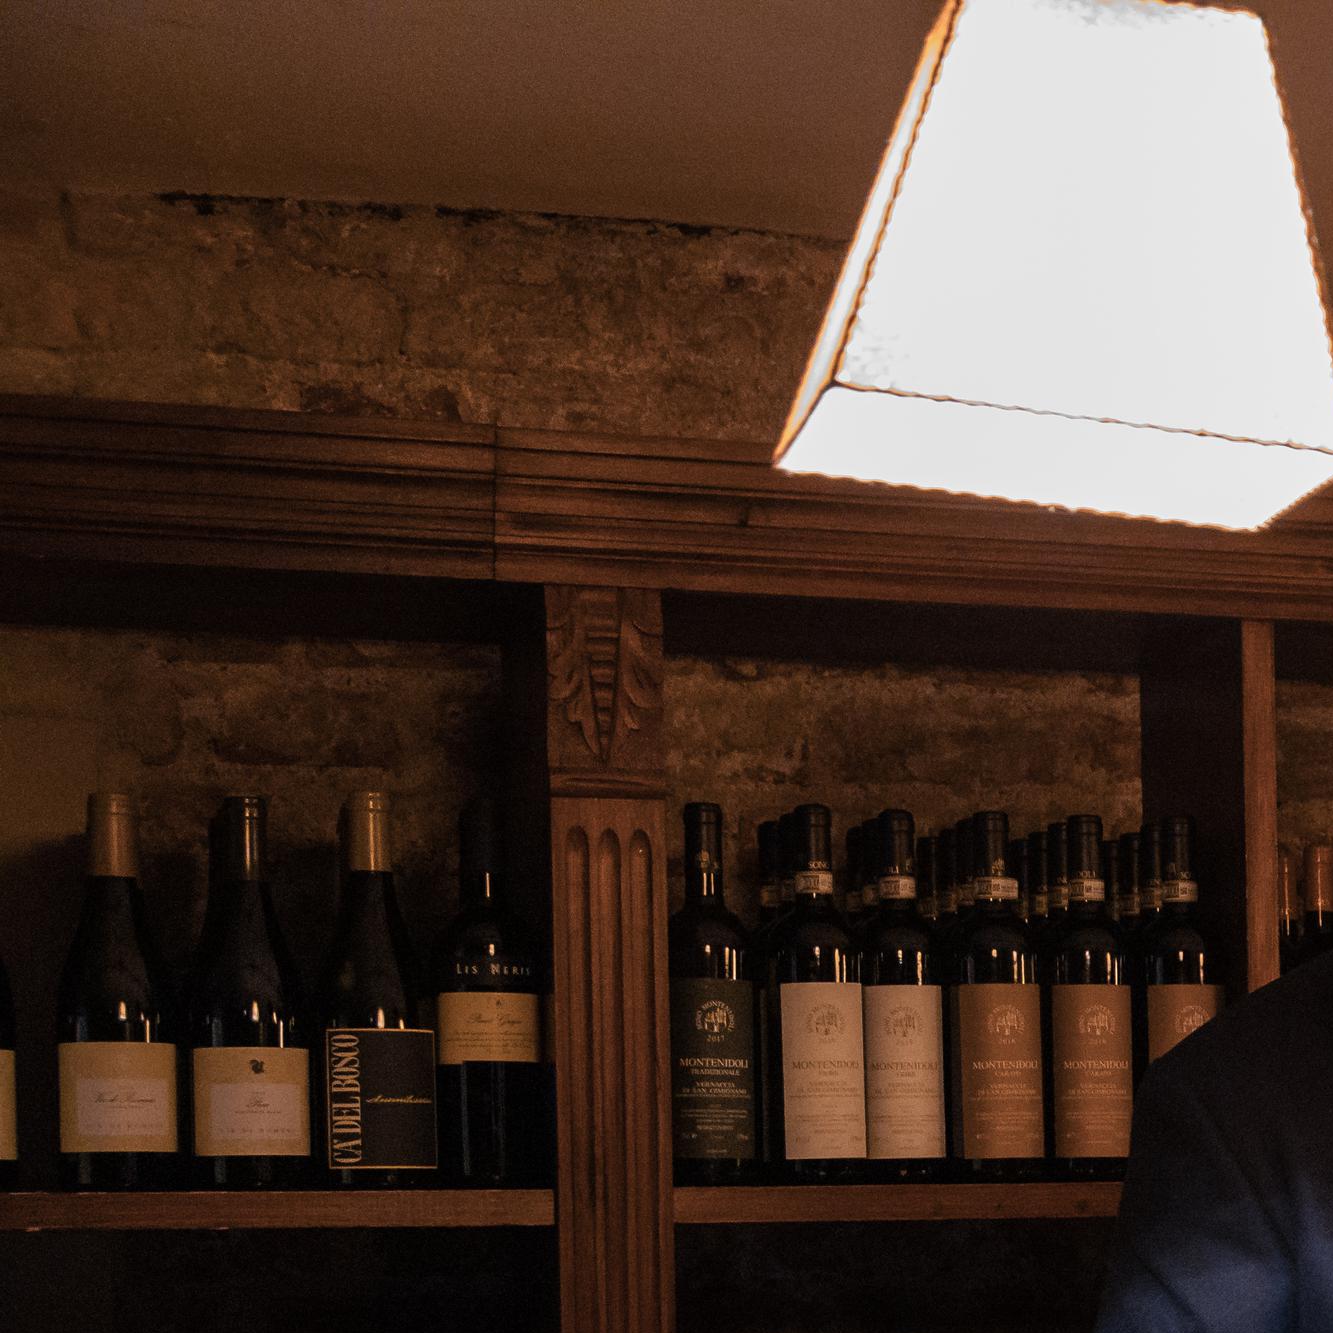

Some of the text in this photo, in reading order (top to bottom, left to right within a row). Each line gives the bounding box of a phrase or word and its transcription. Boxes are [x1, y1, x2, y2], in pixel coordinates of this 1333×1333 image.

[330, 1033, 360, 1093] BOSCO
[679, 1058, 749, 1069] MONTENIDOLI
[792, 1060, 860, 1070] MONTENIDOLI
[871, 1061, 938, 1071] MONTENIDOLI
[972, 1060, 1039, 1070] MONTENIDOLI
[1063, 1060, 1130, 1070] MONTENIDOLI
[332, 1096, 362, 1134] DEL
